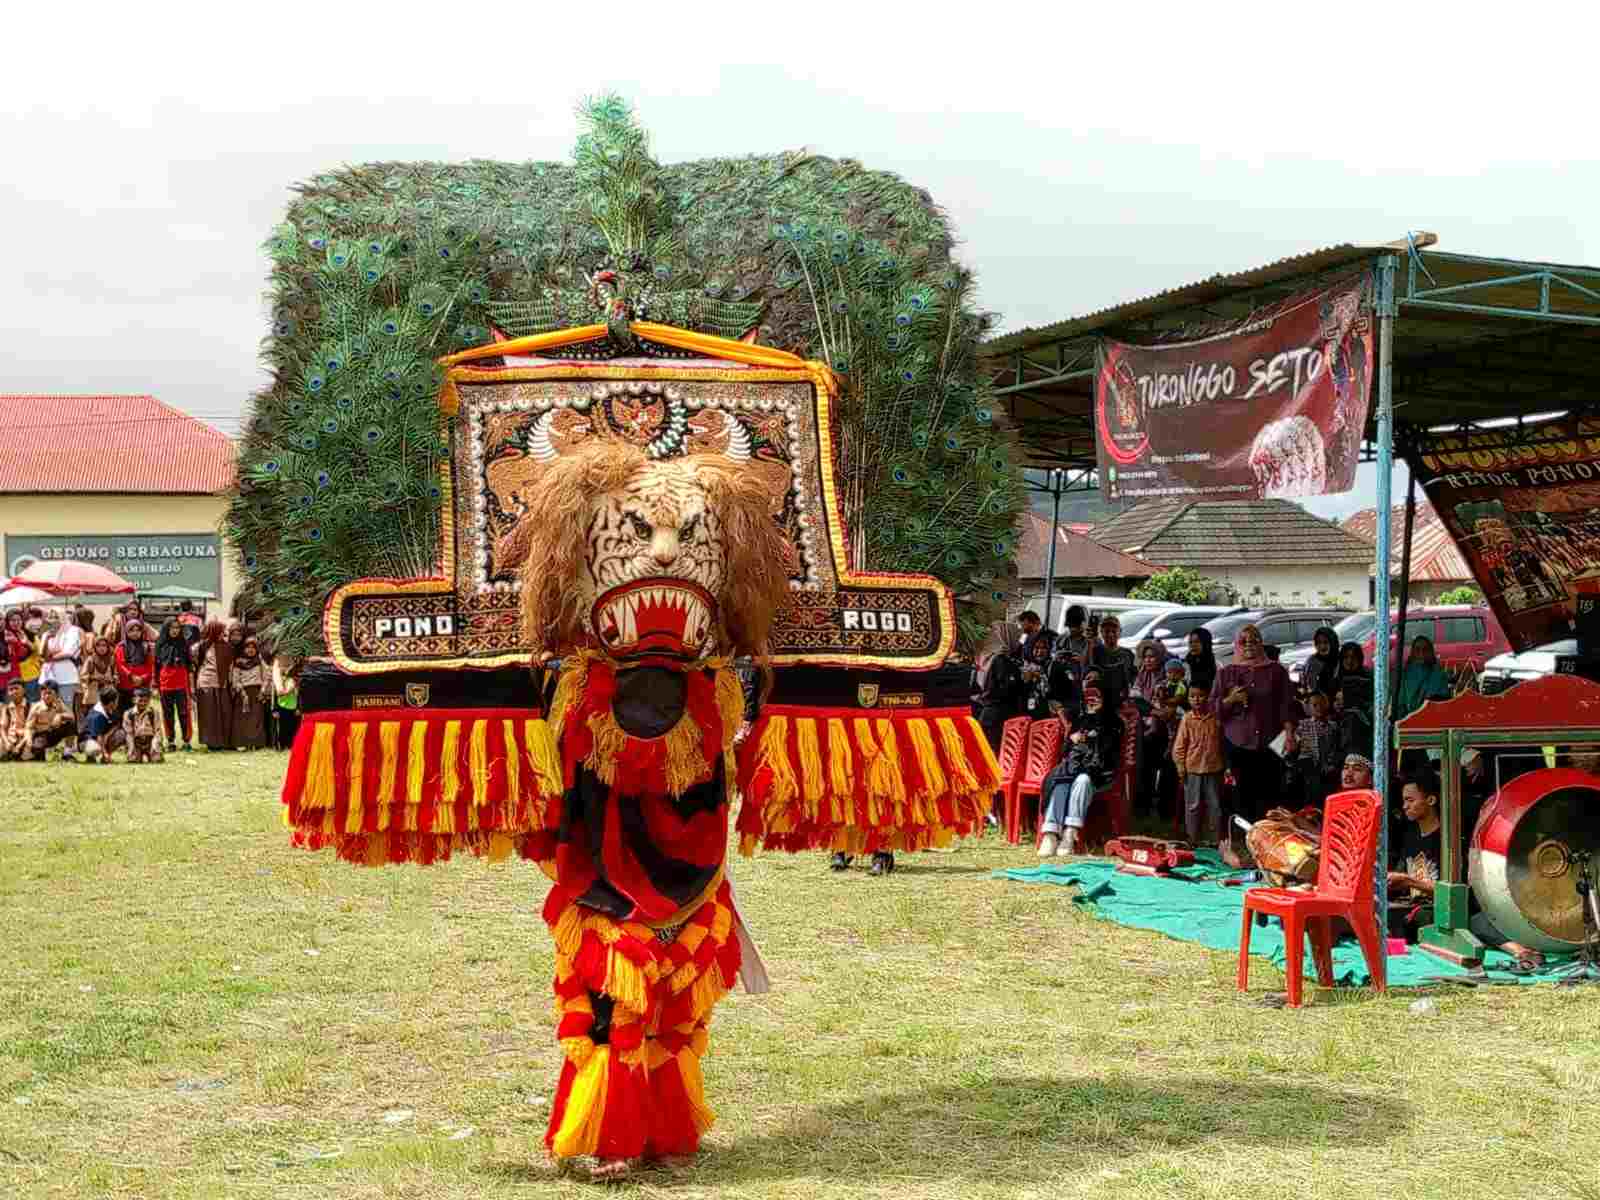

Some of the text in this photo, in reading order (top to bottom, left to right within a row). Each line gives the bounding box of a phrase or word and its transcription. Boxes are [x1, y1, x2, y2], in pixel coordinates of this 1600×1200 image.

[1138, 347, 1322, 419] TURONGGO SETO
[40, 546, 216, 560] GEDUNG SERBAGUNA
[375, 615, 453, 637] PONO
[843, 610, 912, 632] ROGO
